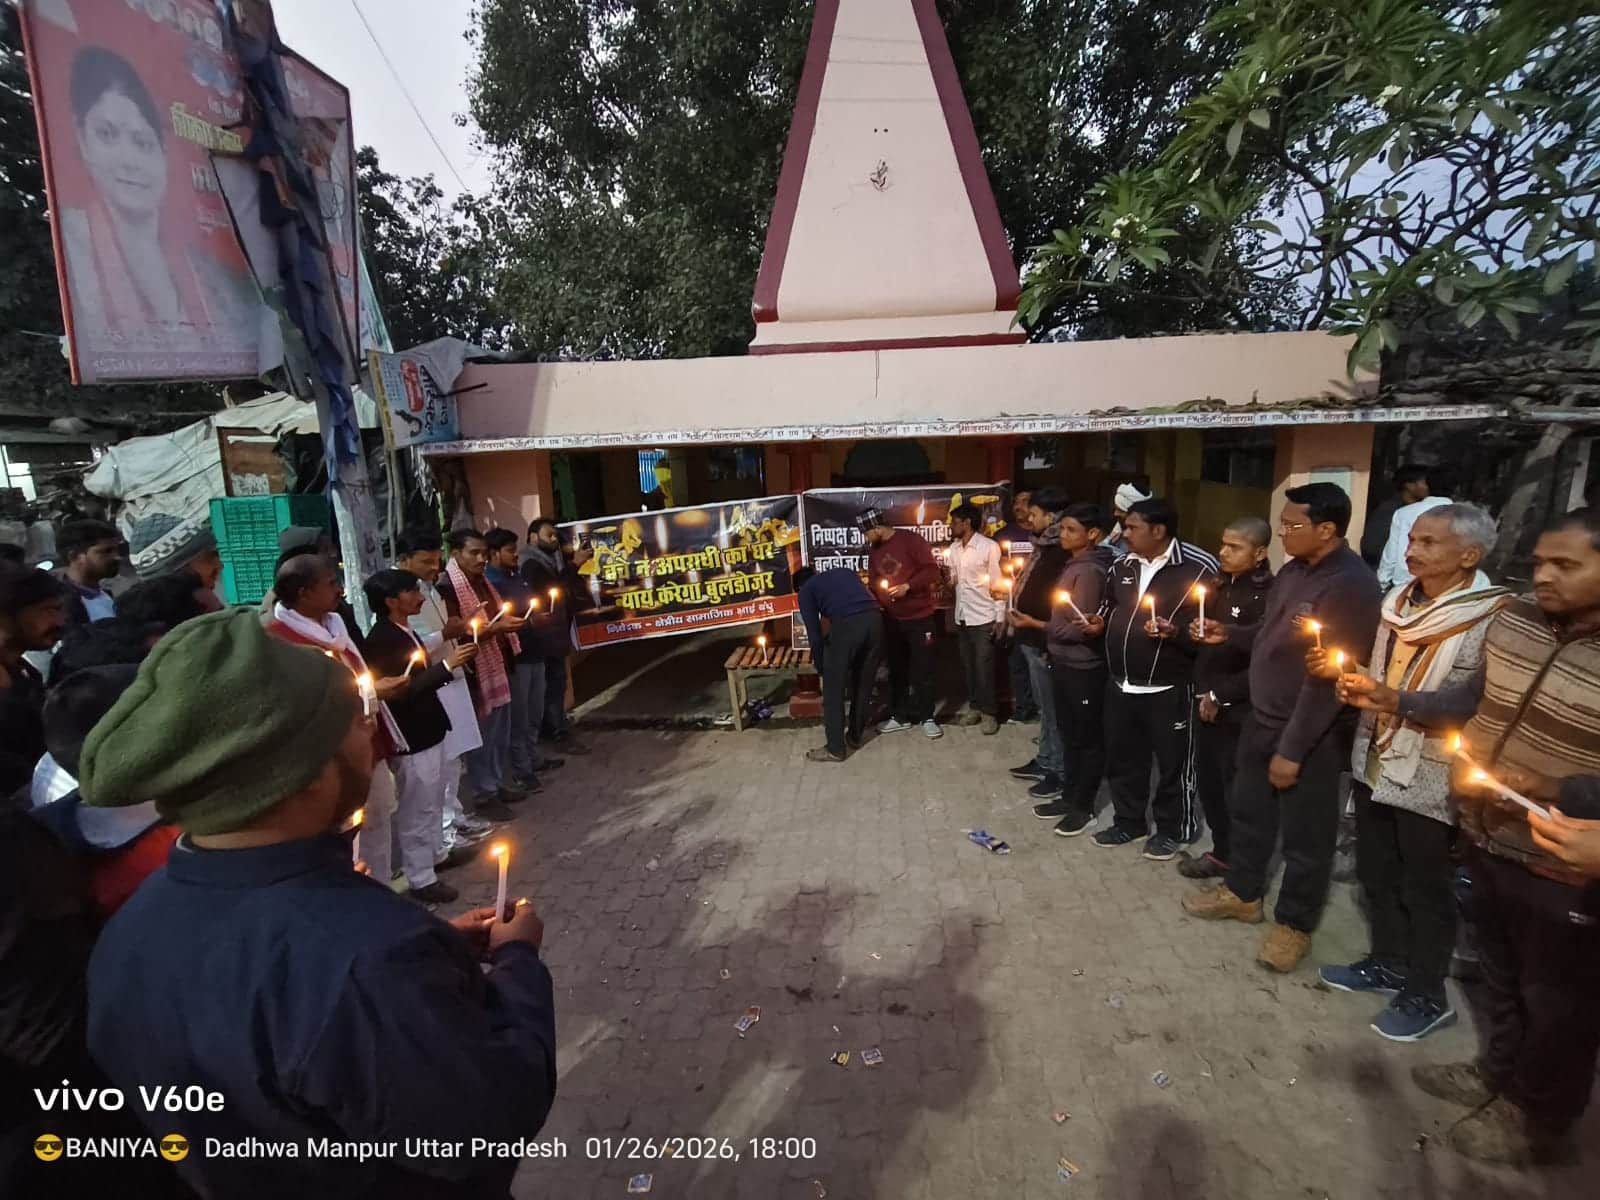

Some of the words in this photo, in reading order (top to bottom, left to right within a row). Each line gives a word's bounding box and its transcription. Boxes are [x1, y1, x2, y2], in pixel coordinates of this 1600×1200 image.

[655, 545, 721, 576] अपराधी
[724, 545, 748, 565] का
[752, 541, 776, 561] घर
[656, 580, 703, 605] करेगा
[705, 571, 776, 605] बुलडोजर
[686, 609, 734, 623] सामाजिक
